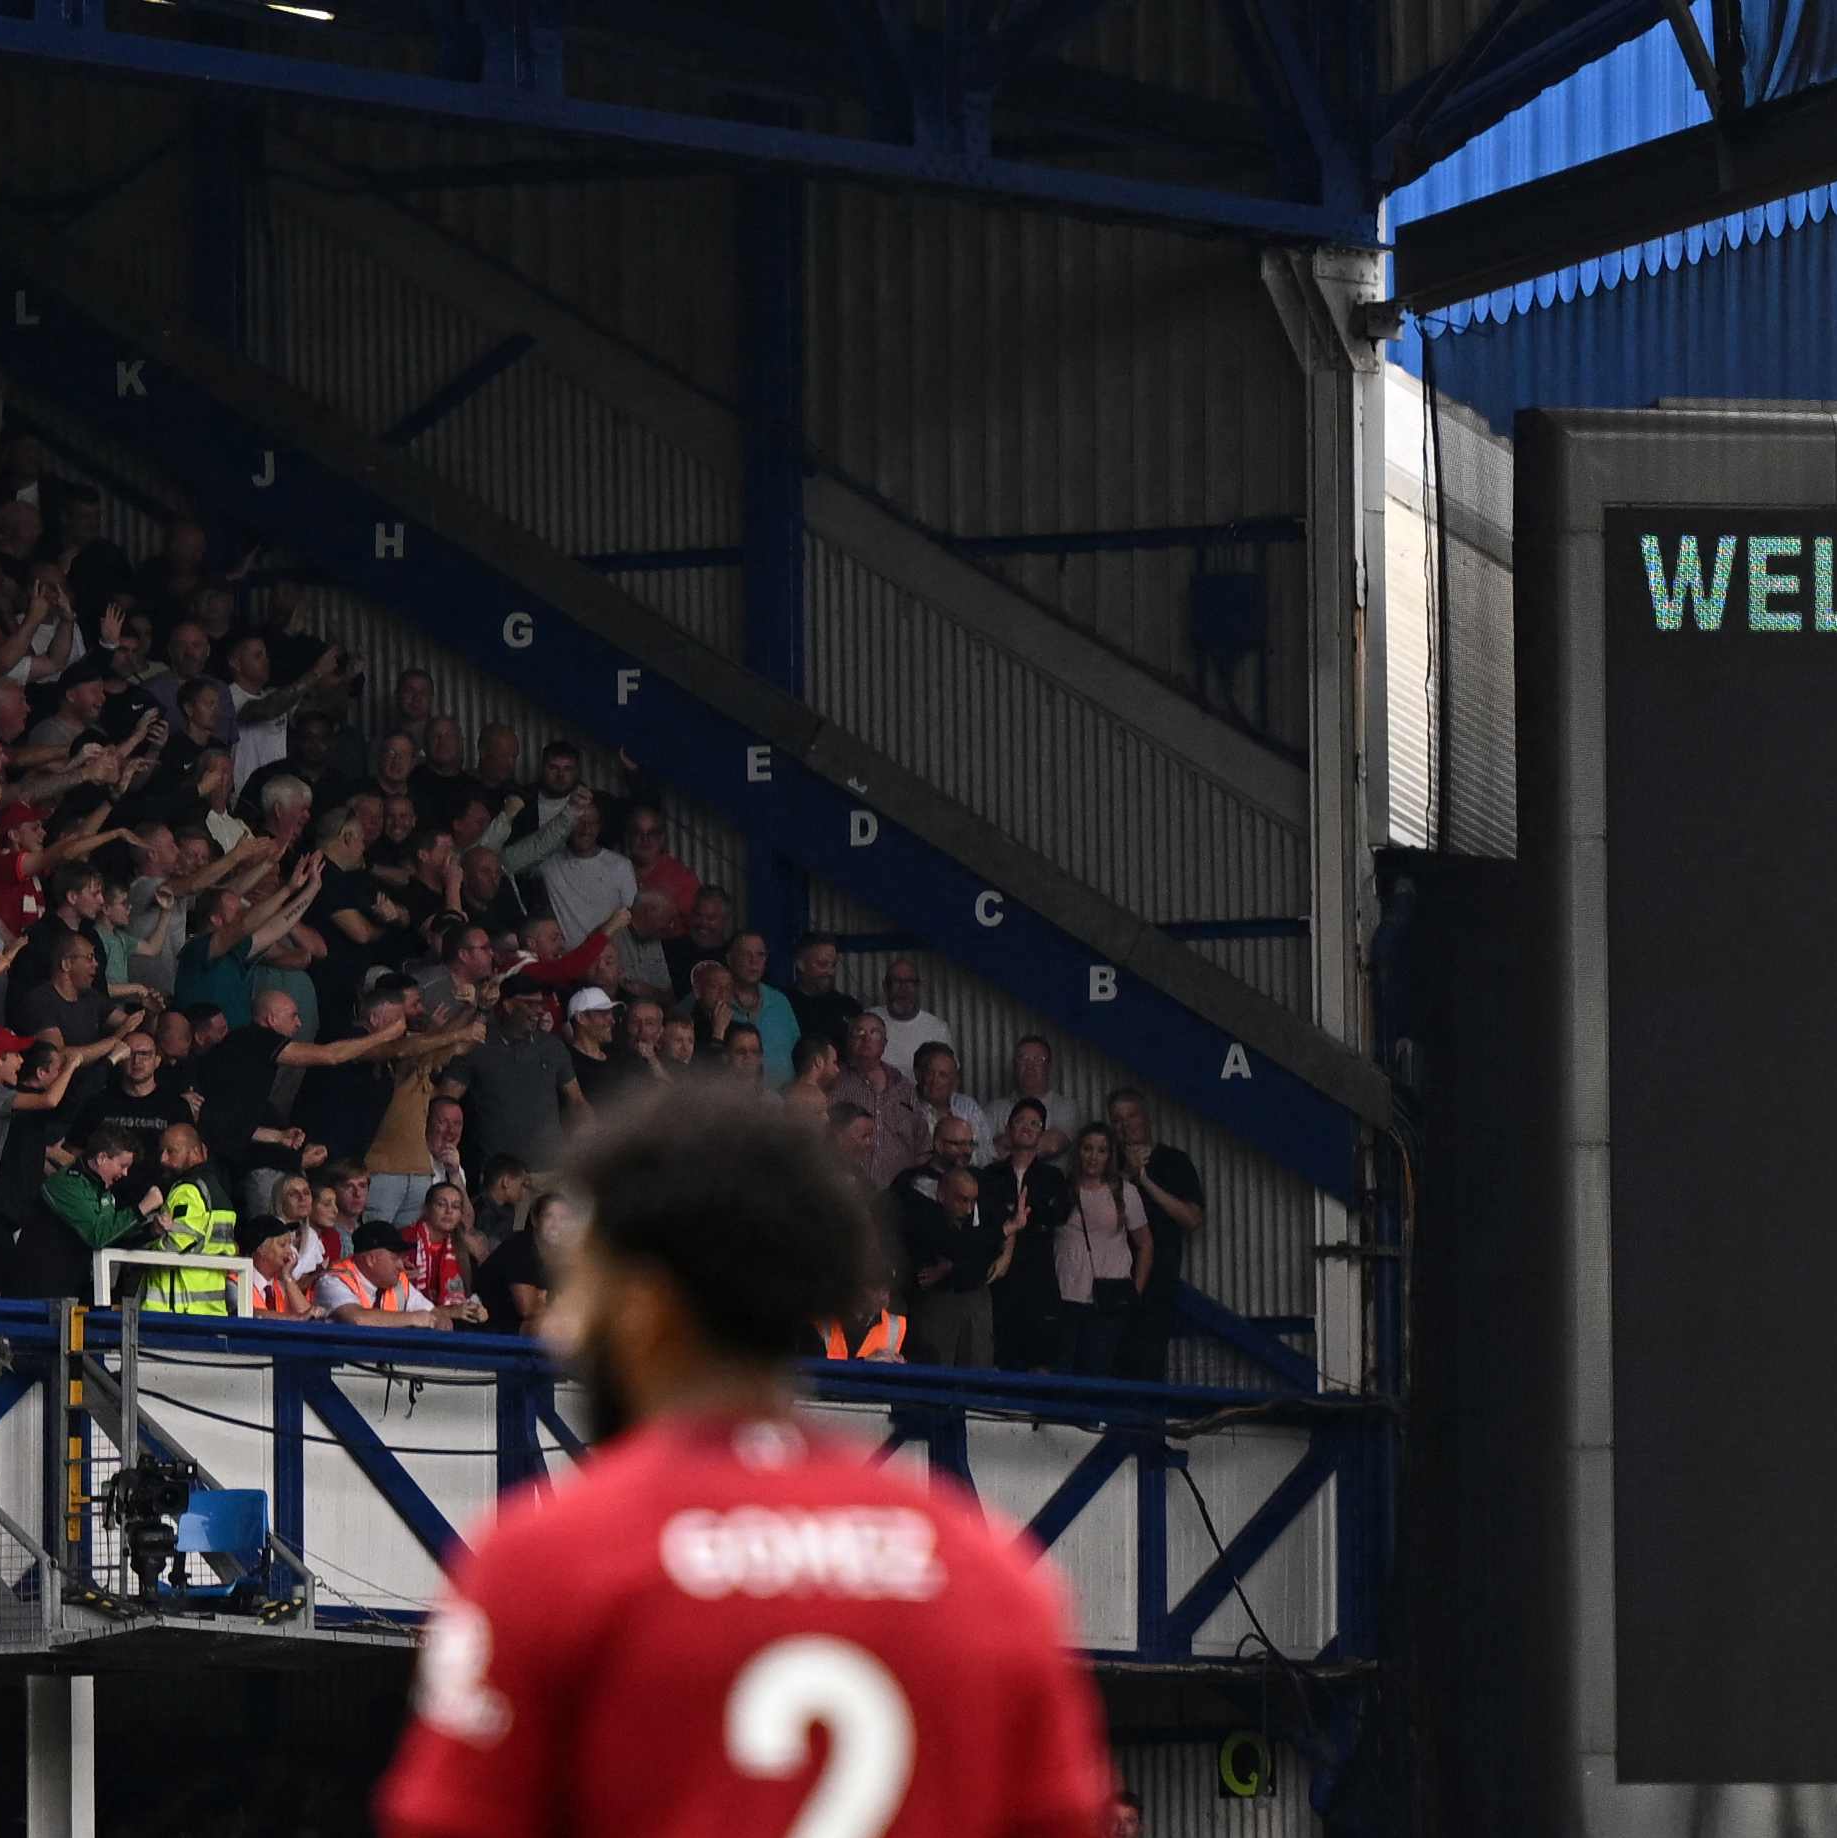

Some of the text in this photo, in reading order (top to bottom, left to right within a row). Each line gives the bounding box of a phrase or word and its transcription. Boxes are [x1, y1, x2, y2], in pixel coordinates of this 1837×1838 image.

[15, 291, 40, 325] L
[116, 361, 147, 397] K
[251, 452, 275, 487] J
[375, 522, 405, 558] H
[502, 612, 533, 648] G
[617, 668, 641, 705] F
[746, 746, 772, 782] E
[850, 810, 878, 847] D
[974, 890, 1004, 927] C
[1089, 965, 1118, 1002] B
[1220, 1043, 1252, 1080] A
